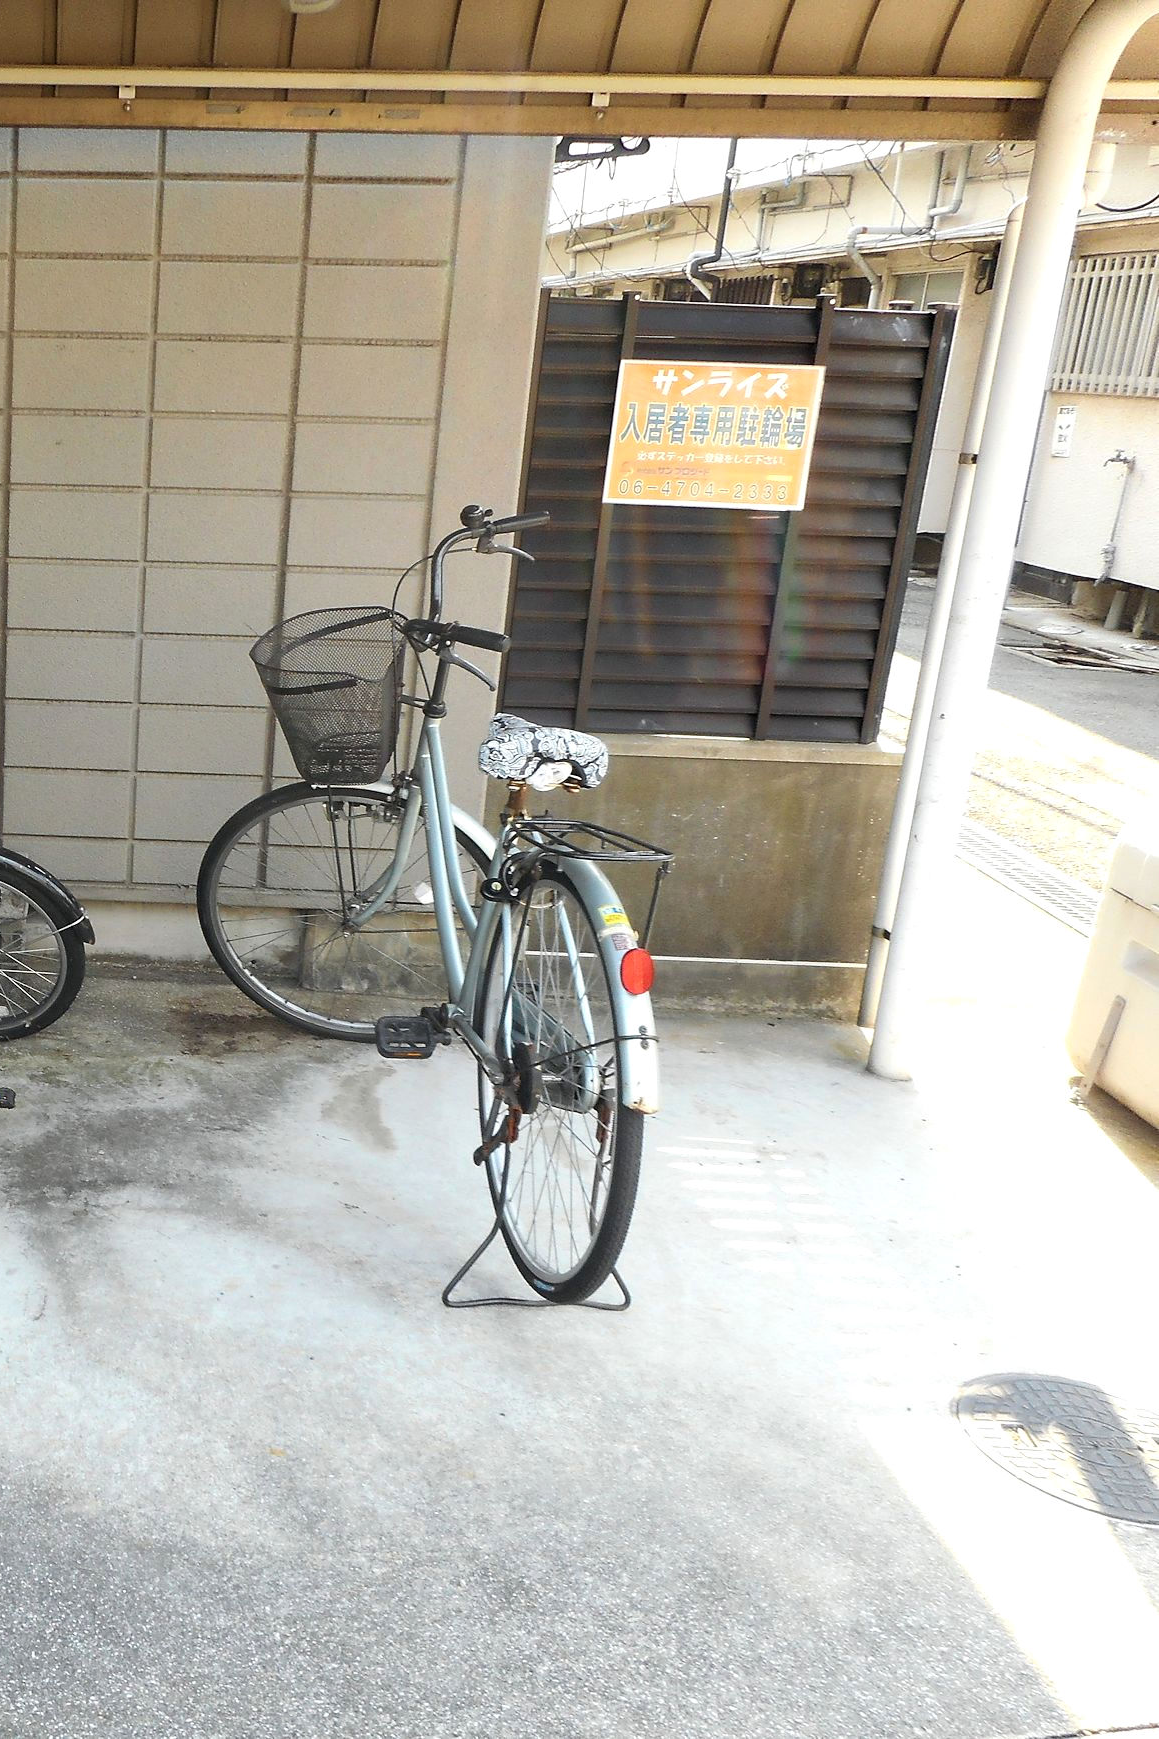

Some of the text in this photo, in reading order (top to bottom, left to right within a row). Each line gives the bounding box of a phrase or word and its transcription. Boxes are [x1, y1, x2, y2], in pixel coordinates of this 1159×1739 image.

[653, 369, 790, 398] サンライズ
[620, 403, 808, 449] 入居者専用駐輪場
[619, 479, 787, 500] 06-4704-2333
